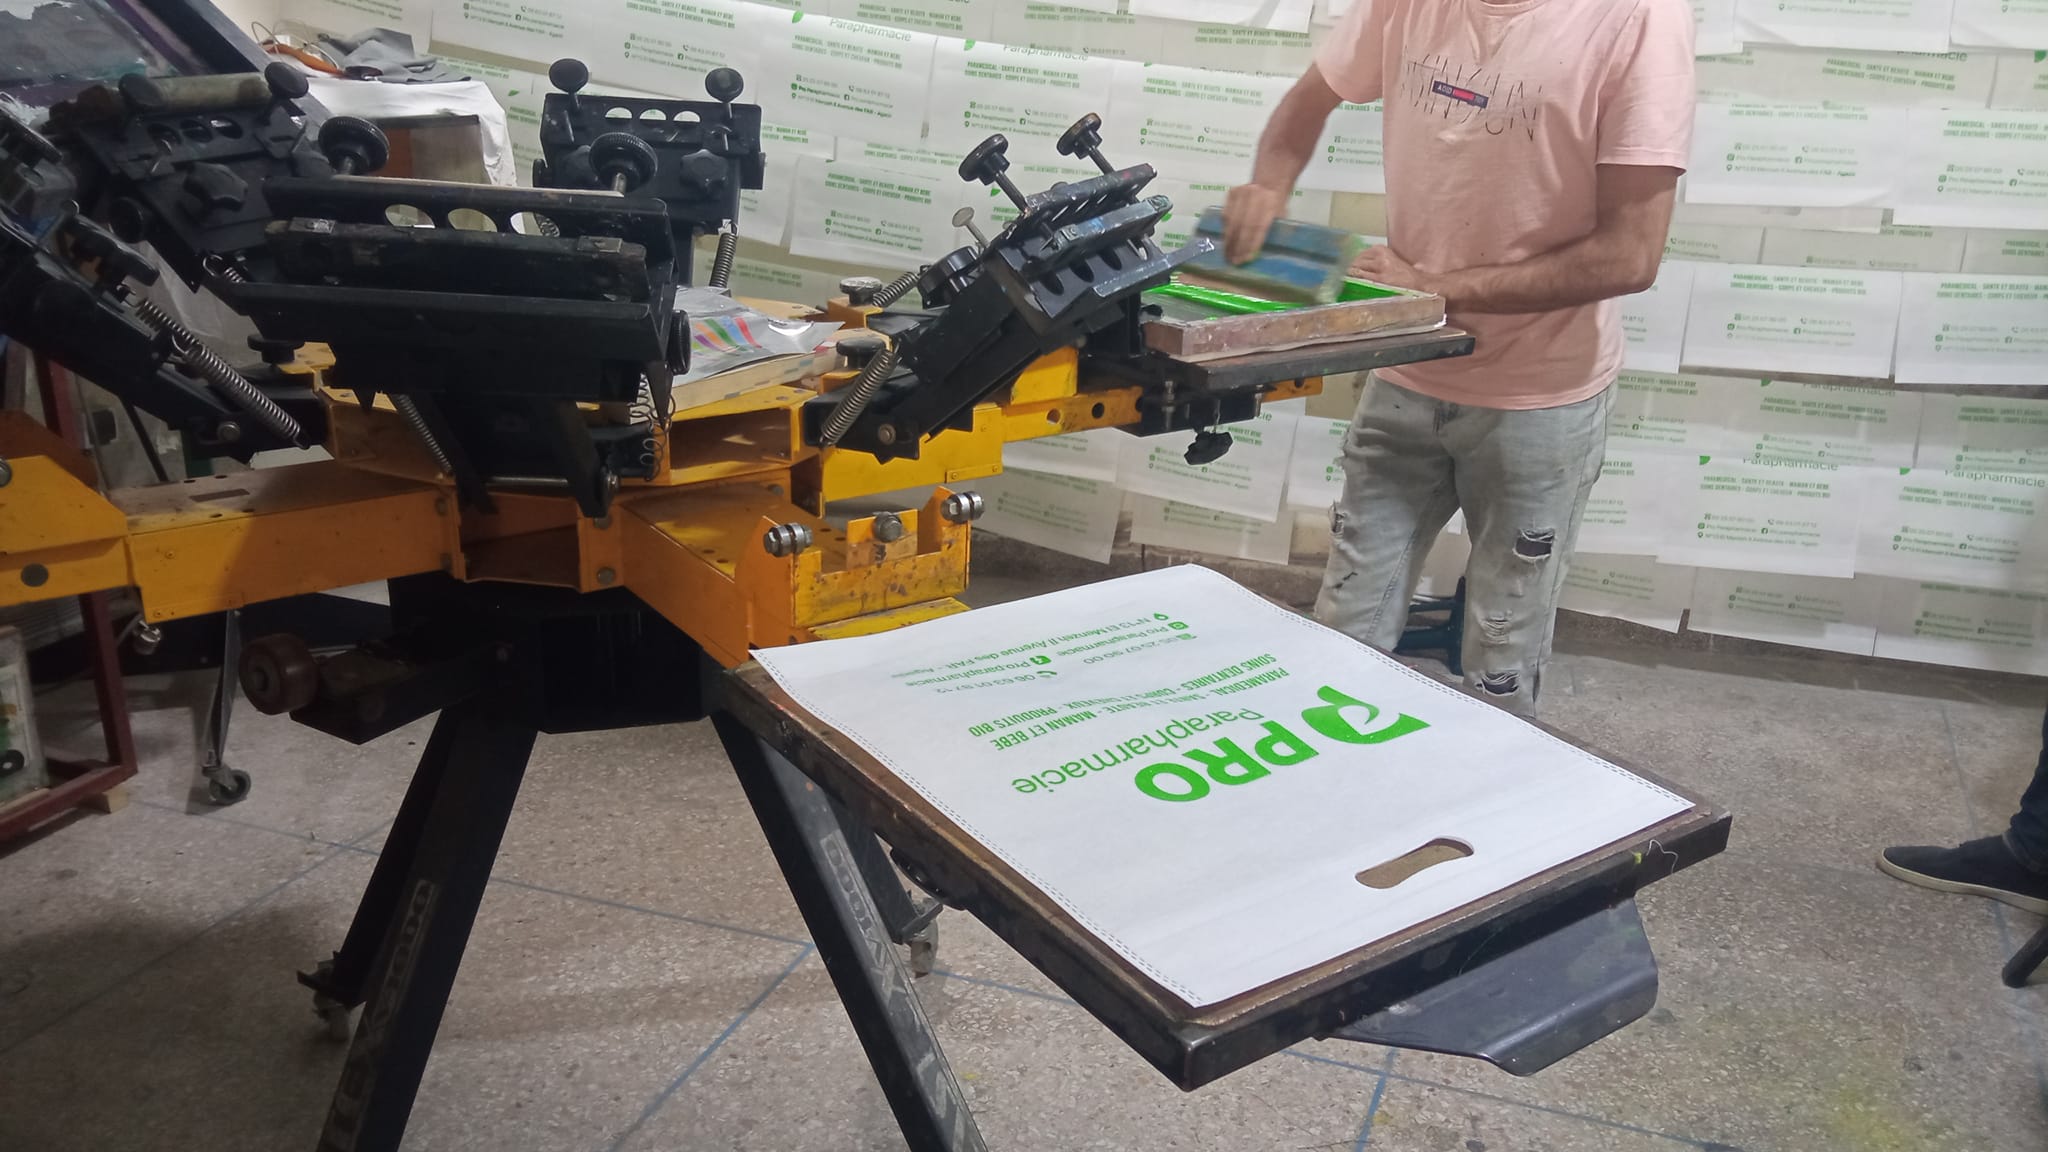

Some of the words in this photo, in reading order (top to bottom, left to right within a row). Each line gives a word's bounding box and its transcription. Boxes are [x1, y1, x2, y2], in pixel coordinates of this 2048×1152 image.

[829, 18, 912, 42] Parapharmacie
[1147, 626, 1169, 635] Pro
[974, 652, 1000, 661] des
[1000, 641, 1048, 656] Avenue
[1083, 655, 1105, 664] 00
[1240, 653, 1277, 671] SOINS
[1181, 665, 1245, 691] DENTAIRES
[1210, 667, 1290, 696] PARAMEDICAL
[993, 707, 1057, 729] PRODUITS
[1045, 710, 1097, 731] MAMAN
[968, 722, 995, 737] BIO
[991, 728, 1031, 751] BEBE
[1028, 723, 1048, 738] ET
[1011, 707, 1265, 793] Parapharmacie
[1135, 720, 1319, 801] PRO
